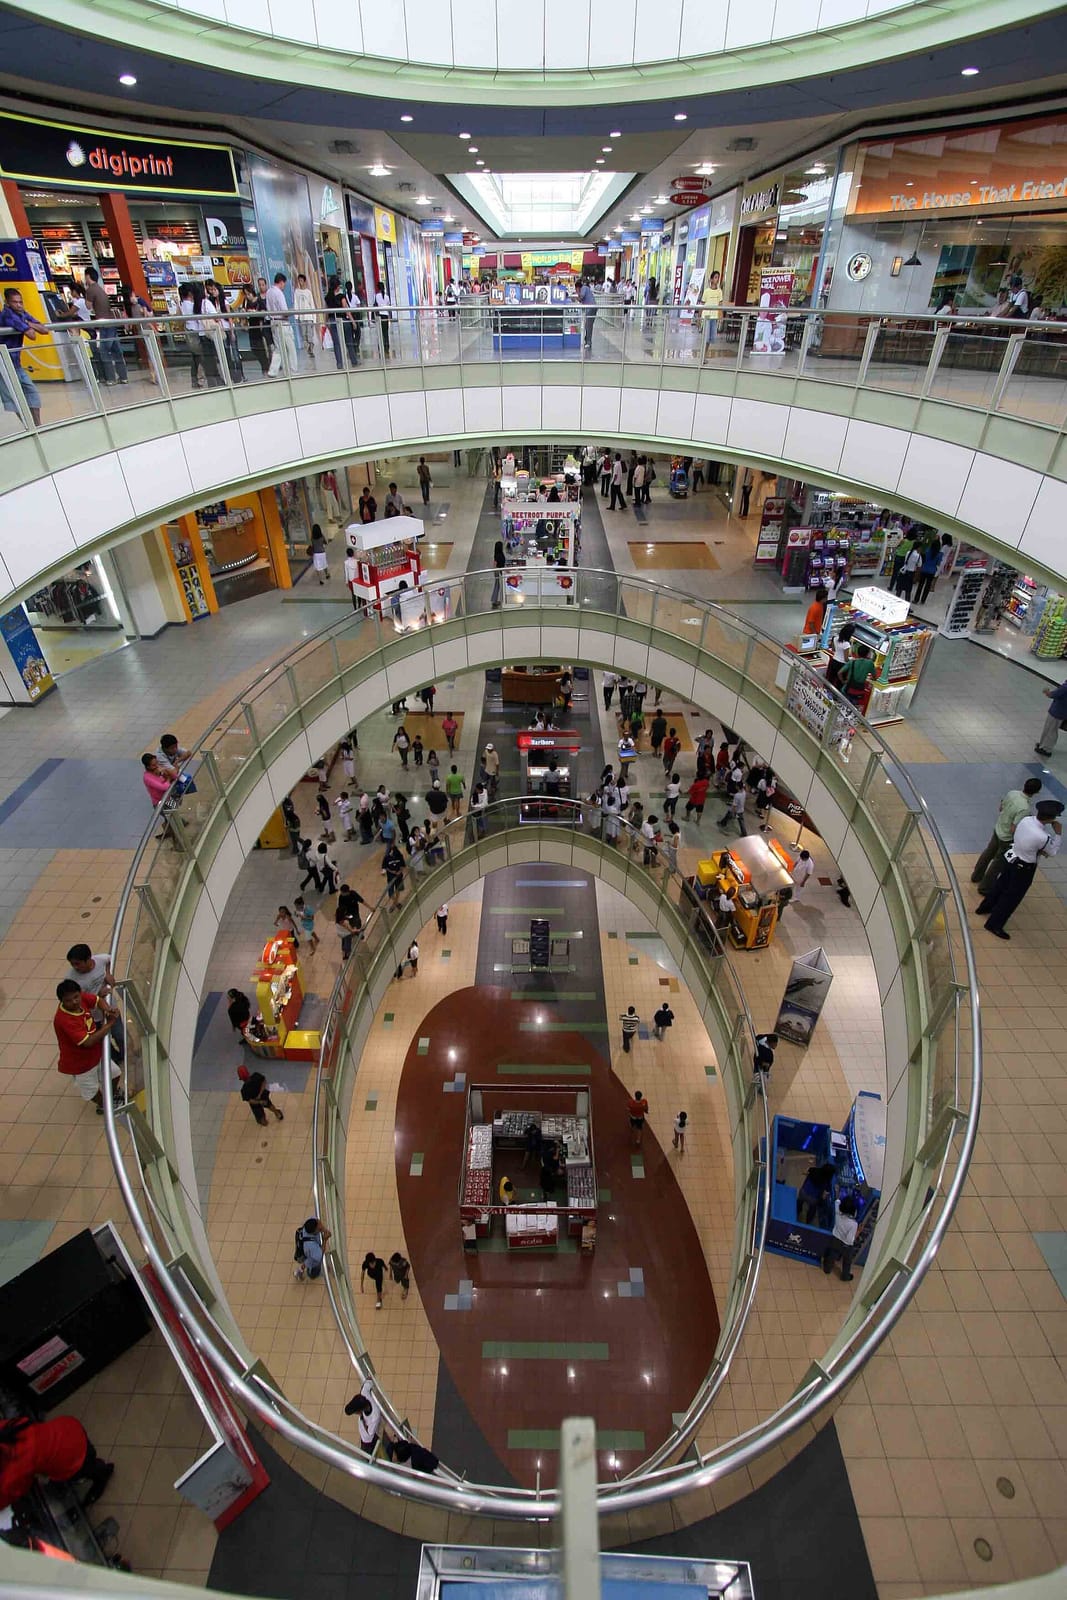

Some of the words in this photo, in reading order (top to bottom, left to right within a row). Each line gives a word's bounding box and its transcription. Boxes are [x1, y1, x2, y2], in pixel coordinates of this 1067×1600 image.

[88, 147, 174, 178] digiprint
[889, 194, 917, 211] The
[921, 191, 971, 208] House
[979, 184, 1016, 204] That
[1020, 178, 1067, 200] Fried
